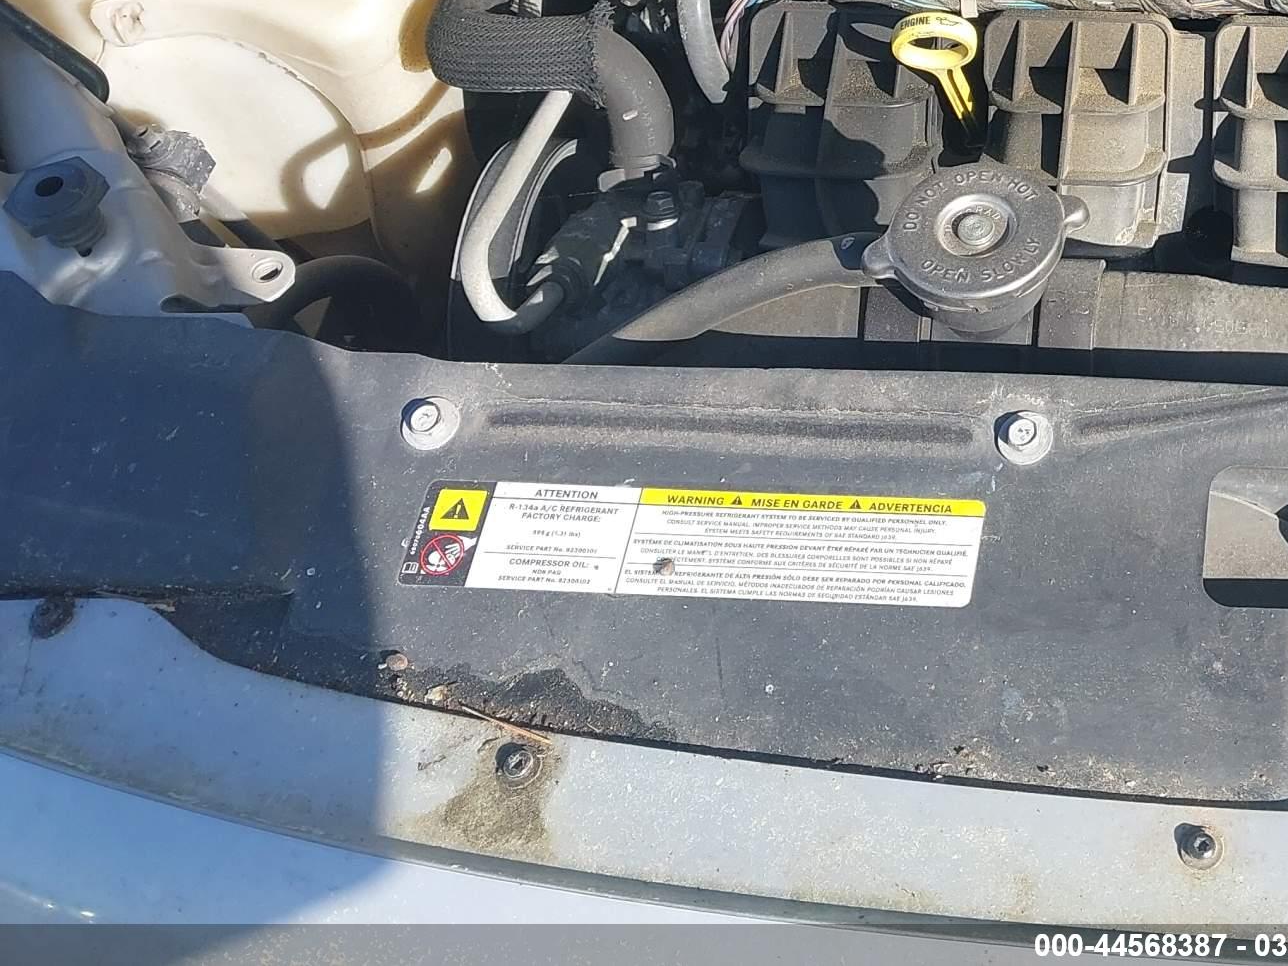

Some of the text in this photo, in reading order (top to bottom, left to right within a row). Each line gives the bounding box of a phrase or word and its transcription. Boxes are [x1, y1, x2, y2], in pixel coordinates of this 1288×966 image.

[900, 16, 931, 30] ENGINE
[902, 209, 920, 232] DO
[918, 180, 950, 207] NOT
[953, 170, 1003, 187] OPEN
[1007, 176, 1041, 202] HOT
[920, 237, 1042, 284] OPEN SLOWLY
[533, 489, 599, 500] ATTENTION
[508, 503, 619, 515] R-134a A/C REFRIGERANT
[667, 494, 953, 514] WARNING MISE EN GARDE ADVERTENCIA
[521, 512, 601, 523] FACTORY CHARGE:
[662, 510, 714, 518] HIGH-PRESSURE
[509, 558, 591, 569] COMPRESSOR OIL:
[497, 575, 527, 583] SERVICE
